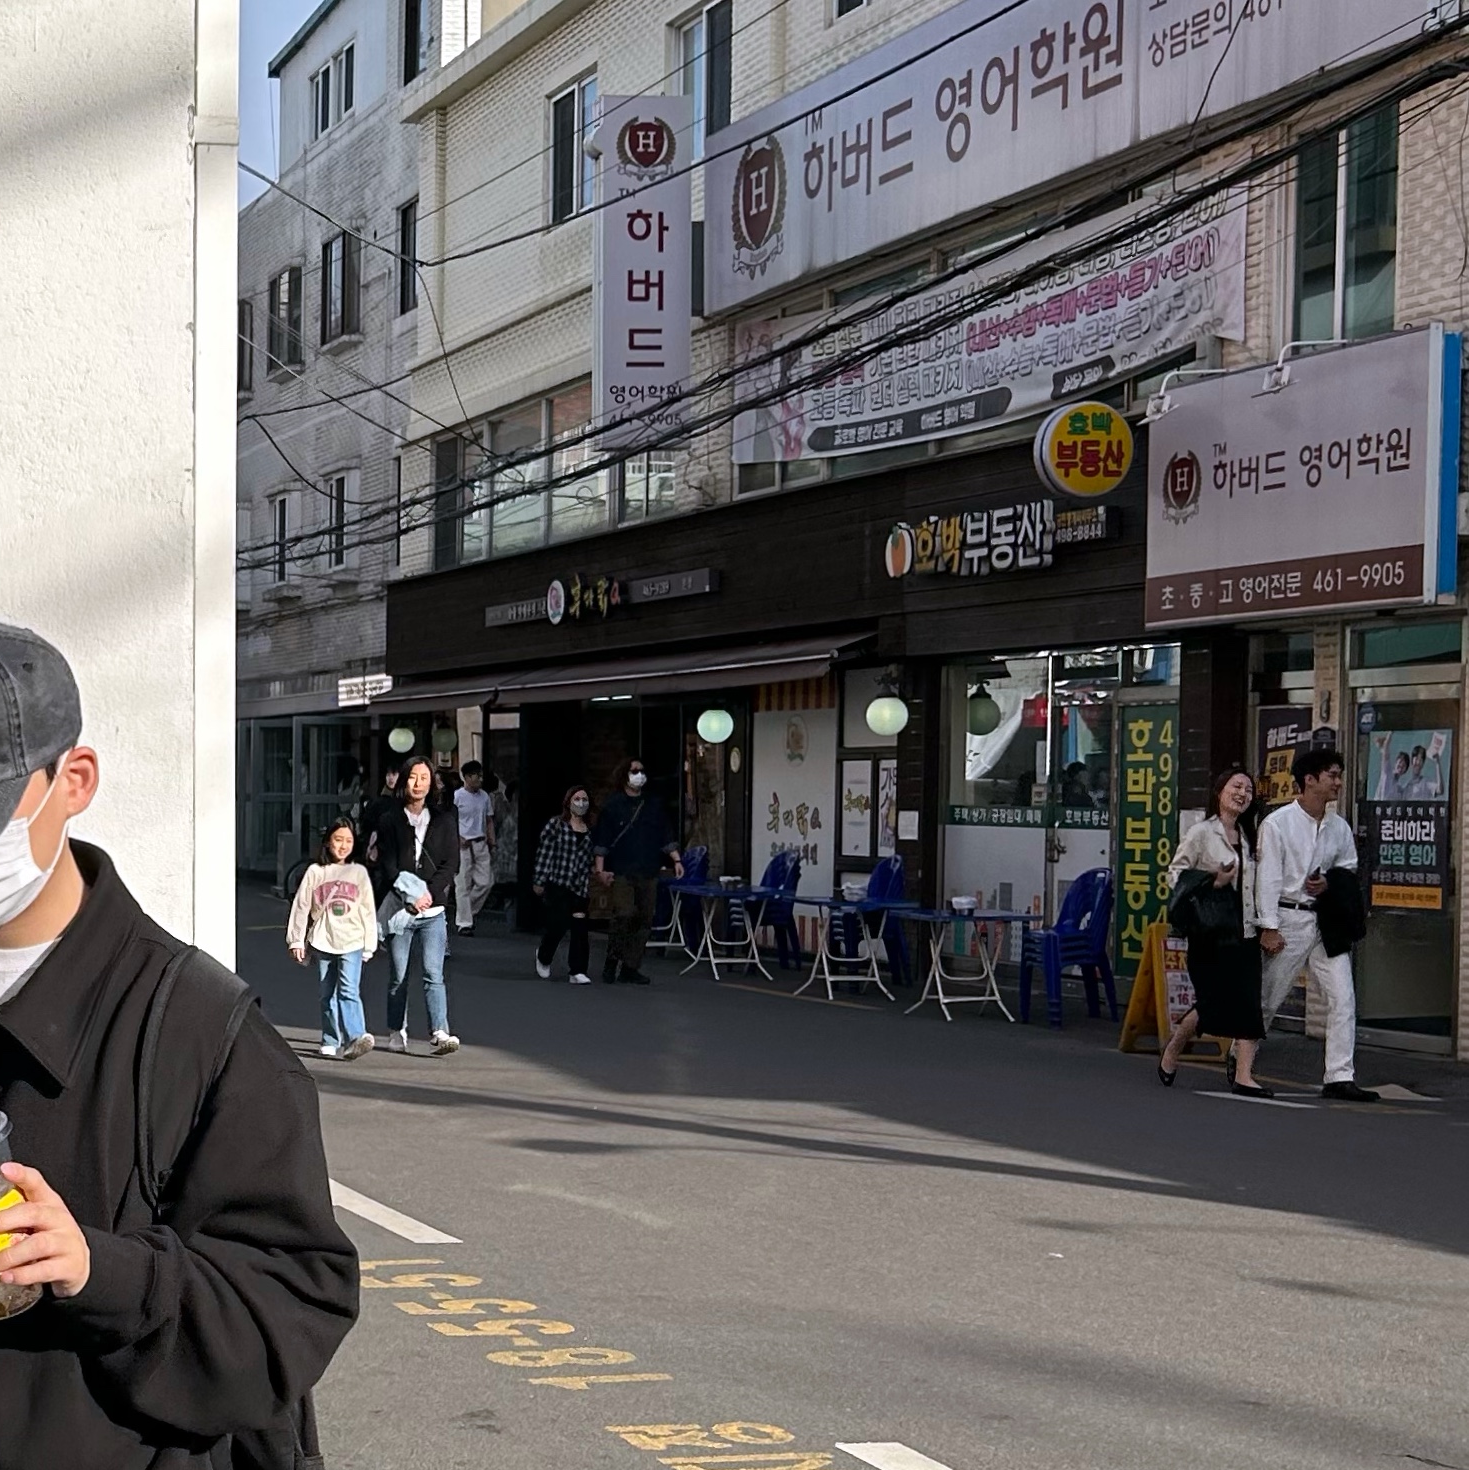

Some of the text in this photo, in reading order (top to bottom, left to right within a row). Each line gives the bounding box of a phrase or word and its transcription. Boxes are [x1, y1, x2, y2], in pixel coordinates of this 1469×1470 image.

[1148, 1, 1232, 67] 상담문의
[803, 0, 1124, 213] 하버드 영어학원
[626, 209, 669, 368] 하버드
[1067, 412, 1113, 436] 호박
[1055, 439, 1125, 479] 부동산
[1212, 427, 1412, 498] 하버드 영어학원
[1055, 521, 1103, 544] 498-8844
[1239, 571, 1302, 603] 영어전문
[1313, 561, 1405, 593] 461-9905
[1120, 718, 1157, 961] 호박부동산
[1380, 820, 1436, 842] 준비하라
[1378, 844, 1437, 867] 만점 영어
